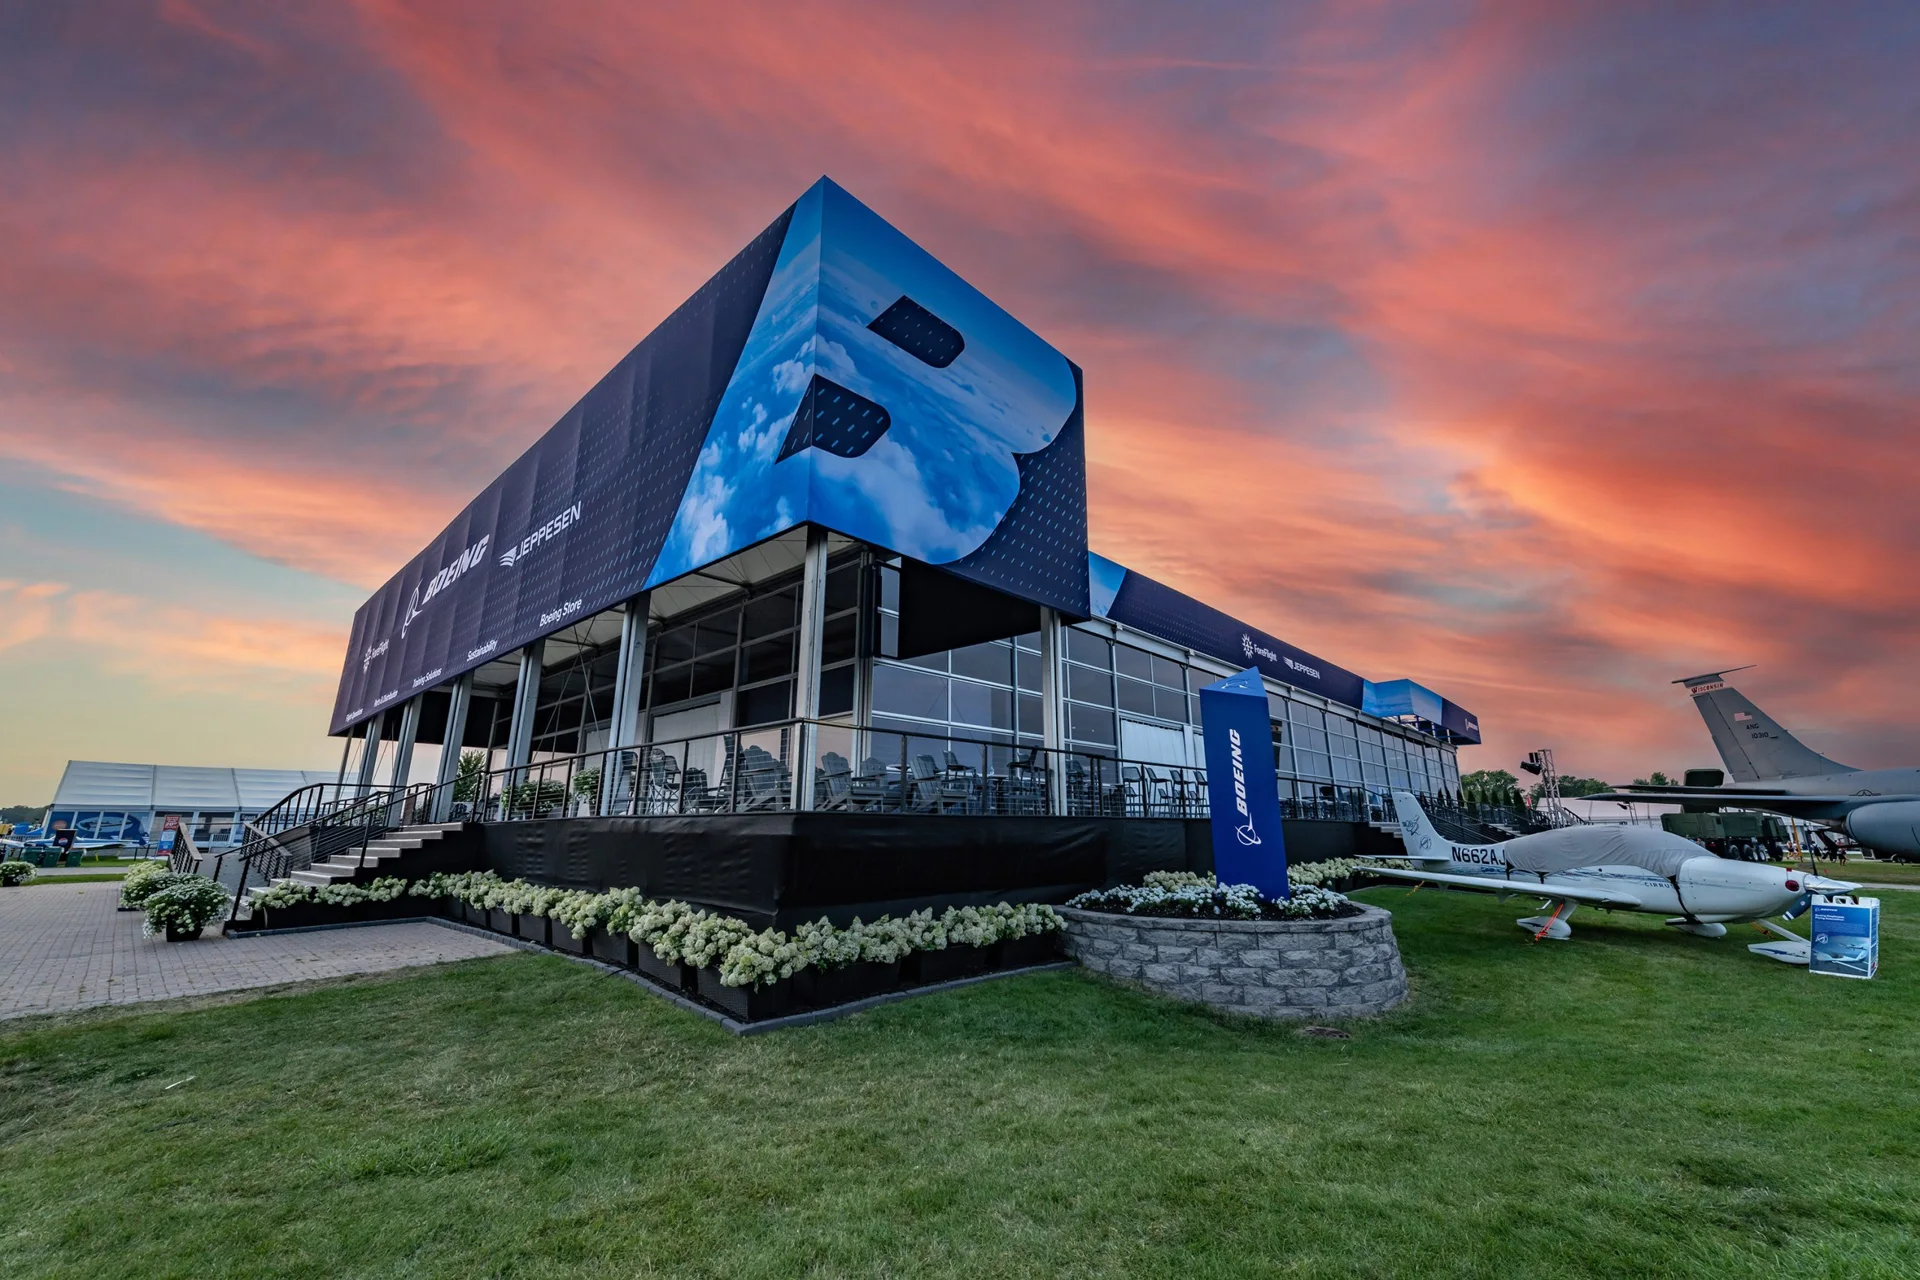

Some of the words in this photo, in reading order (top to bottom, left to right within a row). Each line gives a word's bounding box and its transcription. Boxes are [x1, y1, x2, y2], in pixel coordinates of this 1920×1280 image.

[516, 500, 581, 561] JEPPESEN
[422, 534, 490, 605] BOEING
[539, 608, 562, 627] Boeing
[562, 598, 583, 616] Store
[466, 639, 498, 661] Sustainability
[1254, 643, 1277, 662] ForeFlight
[1293, 661, 1321, 680] JEPPESEN
[1229, 728, 1249, 817] BOEING
[1451, 846, 1506, 866] N662AJ
